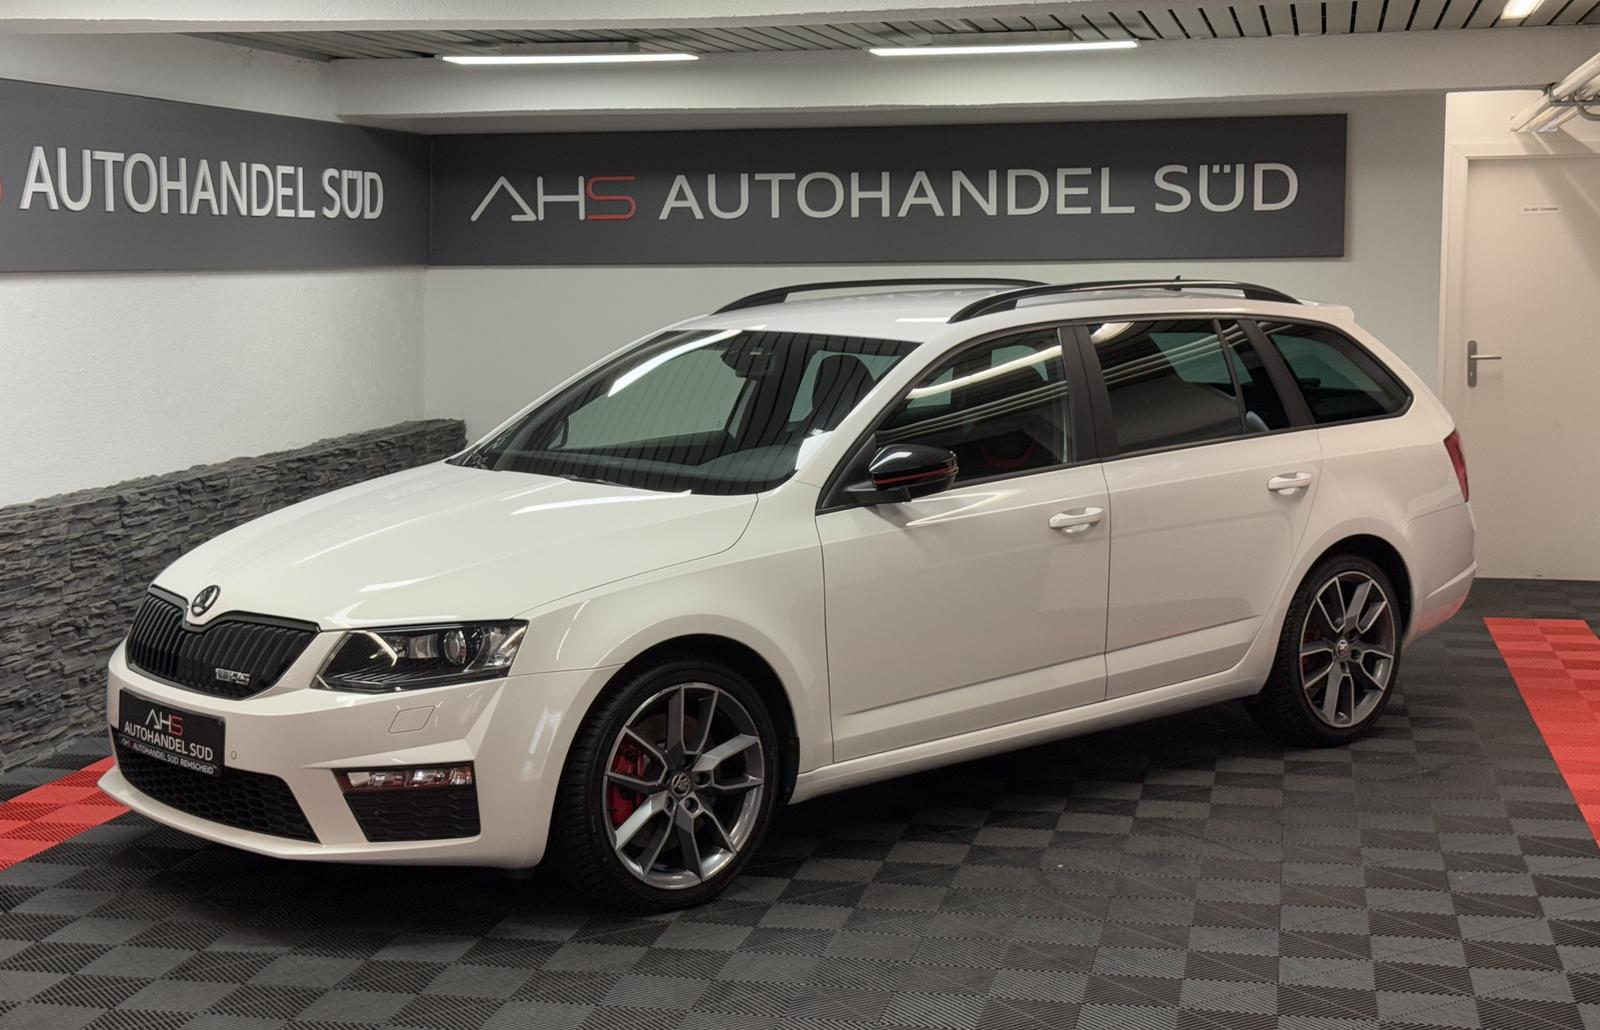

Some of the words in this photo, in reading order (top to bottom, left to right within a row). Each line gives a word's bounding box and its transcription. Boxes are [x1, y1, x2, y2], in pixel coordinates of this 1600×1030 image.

[19, 145, 316, 219] AUTOHANDEL
[321, 167, 384, 219] SÜD
[470, 175, 637, 222] AHS
[658, 166, 1136, 221] AUTOHANDEL
[1153, 162, 1299, 214] SÜD
[124, 721, 188, 755] AUTOHANDEL
[189, 742, 213, 761] SÜD
[145, 708, 183, 736] AHS
[180, 758, 214, 774] REMSCHEID
